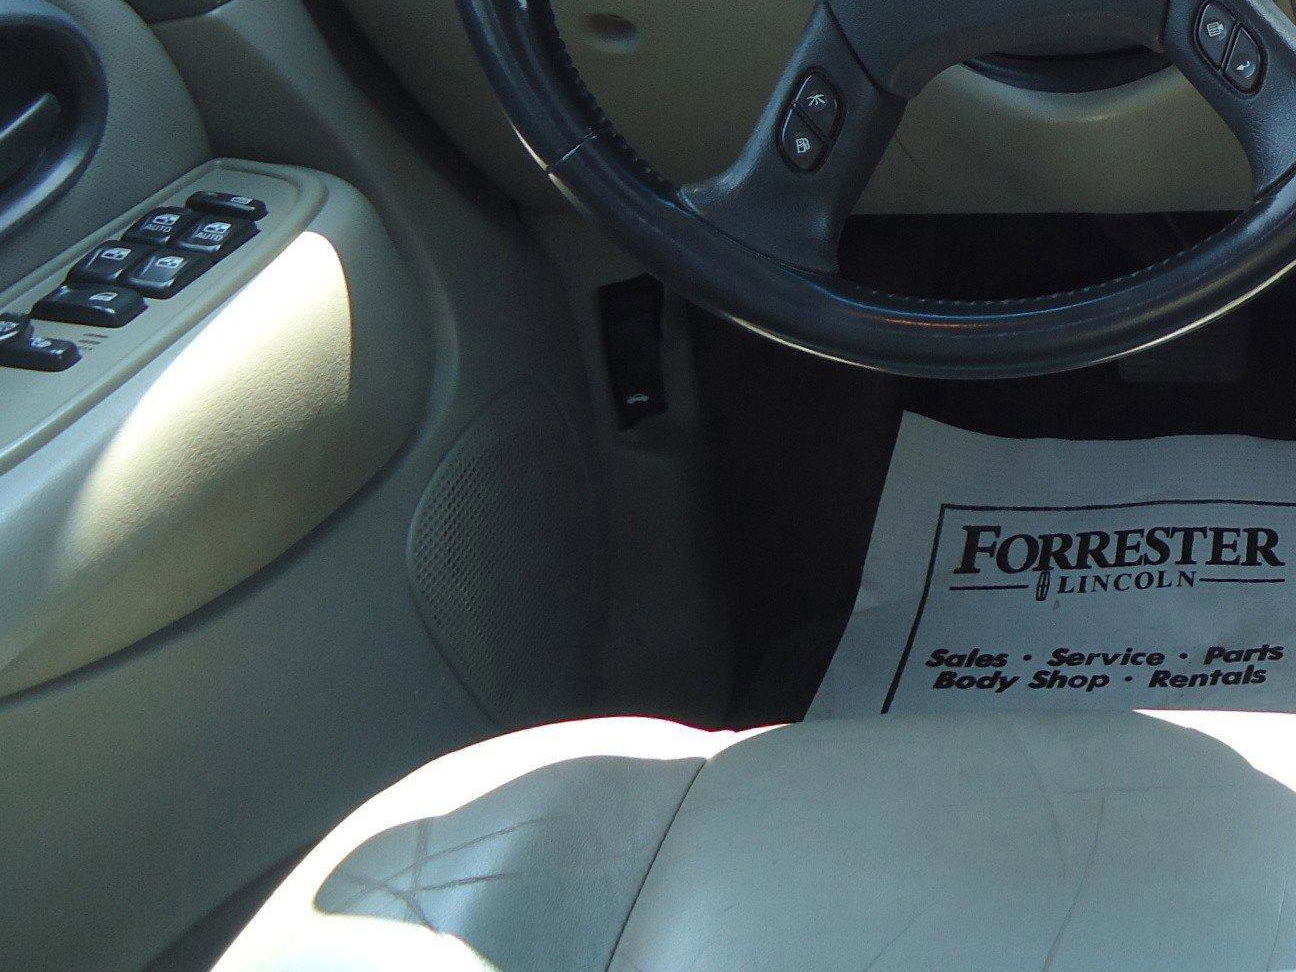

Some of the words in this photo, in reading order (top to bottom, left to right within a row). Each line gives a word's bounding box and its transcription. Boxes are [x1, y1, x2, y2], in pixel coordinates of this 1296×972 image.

[195, 230, 224, 241] AUTO
[953, 525, 1286, 575] FORRESTER
[1057, 570, 1198, 594] LINCOLN
[925, 648, 1008, 669] Sales
[1046, 647, 1166, 668] Service
[1203, 642, 1285, 665] Parts
[931, 670, 1021, 694] Body
[1027, 668, 1111, 692] Shop
[1147, 665, 1268, 689] Rentals
